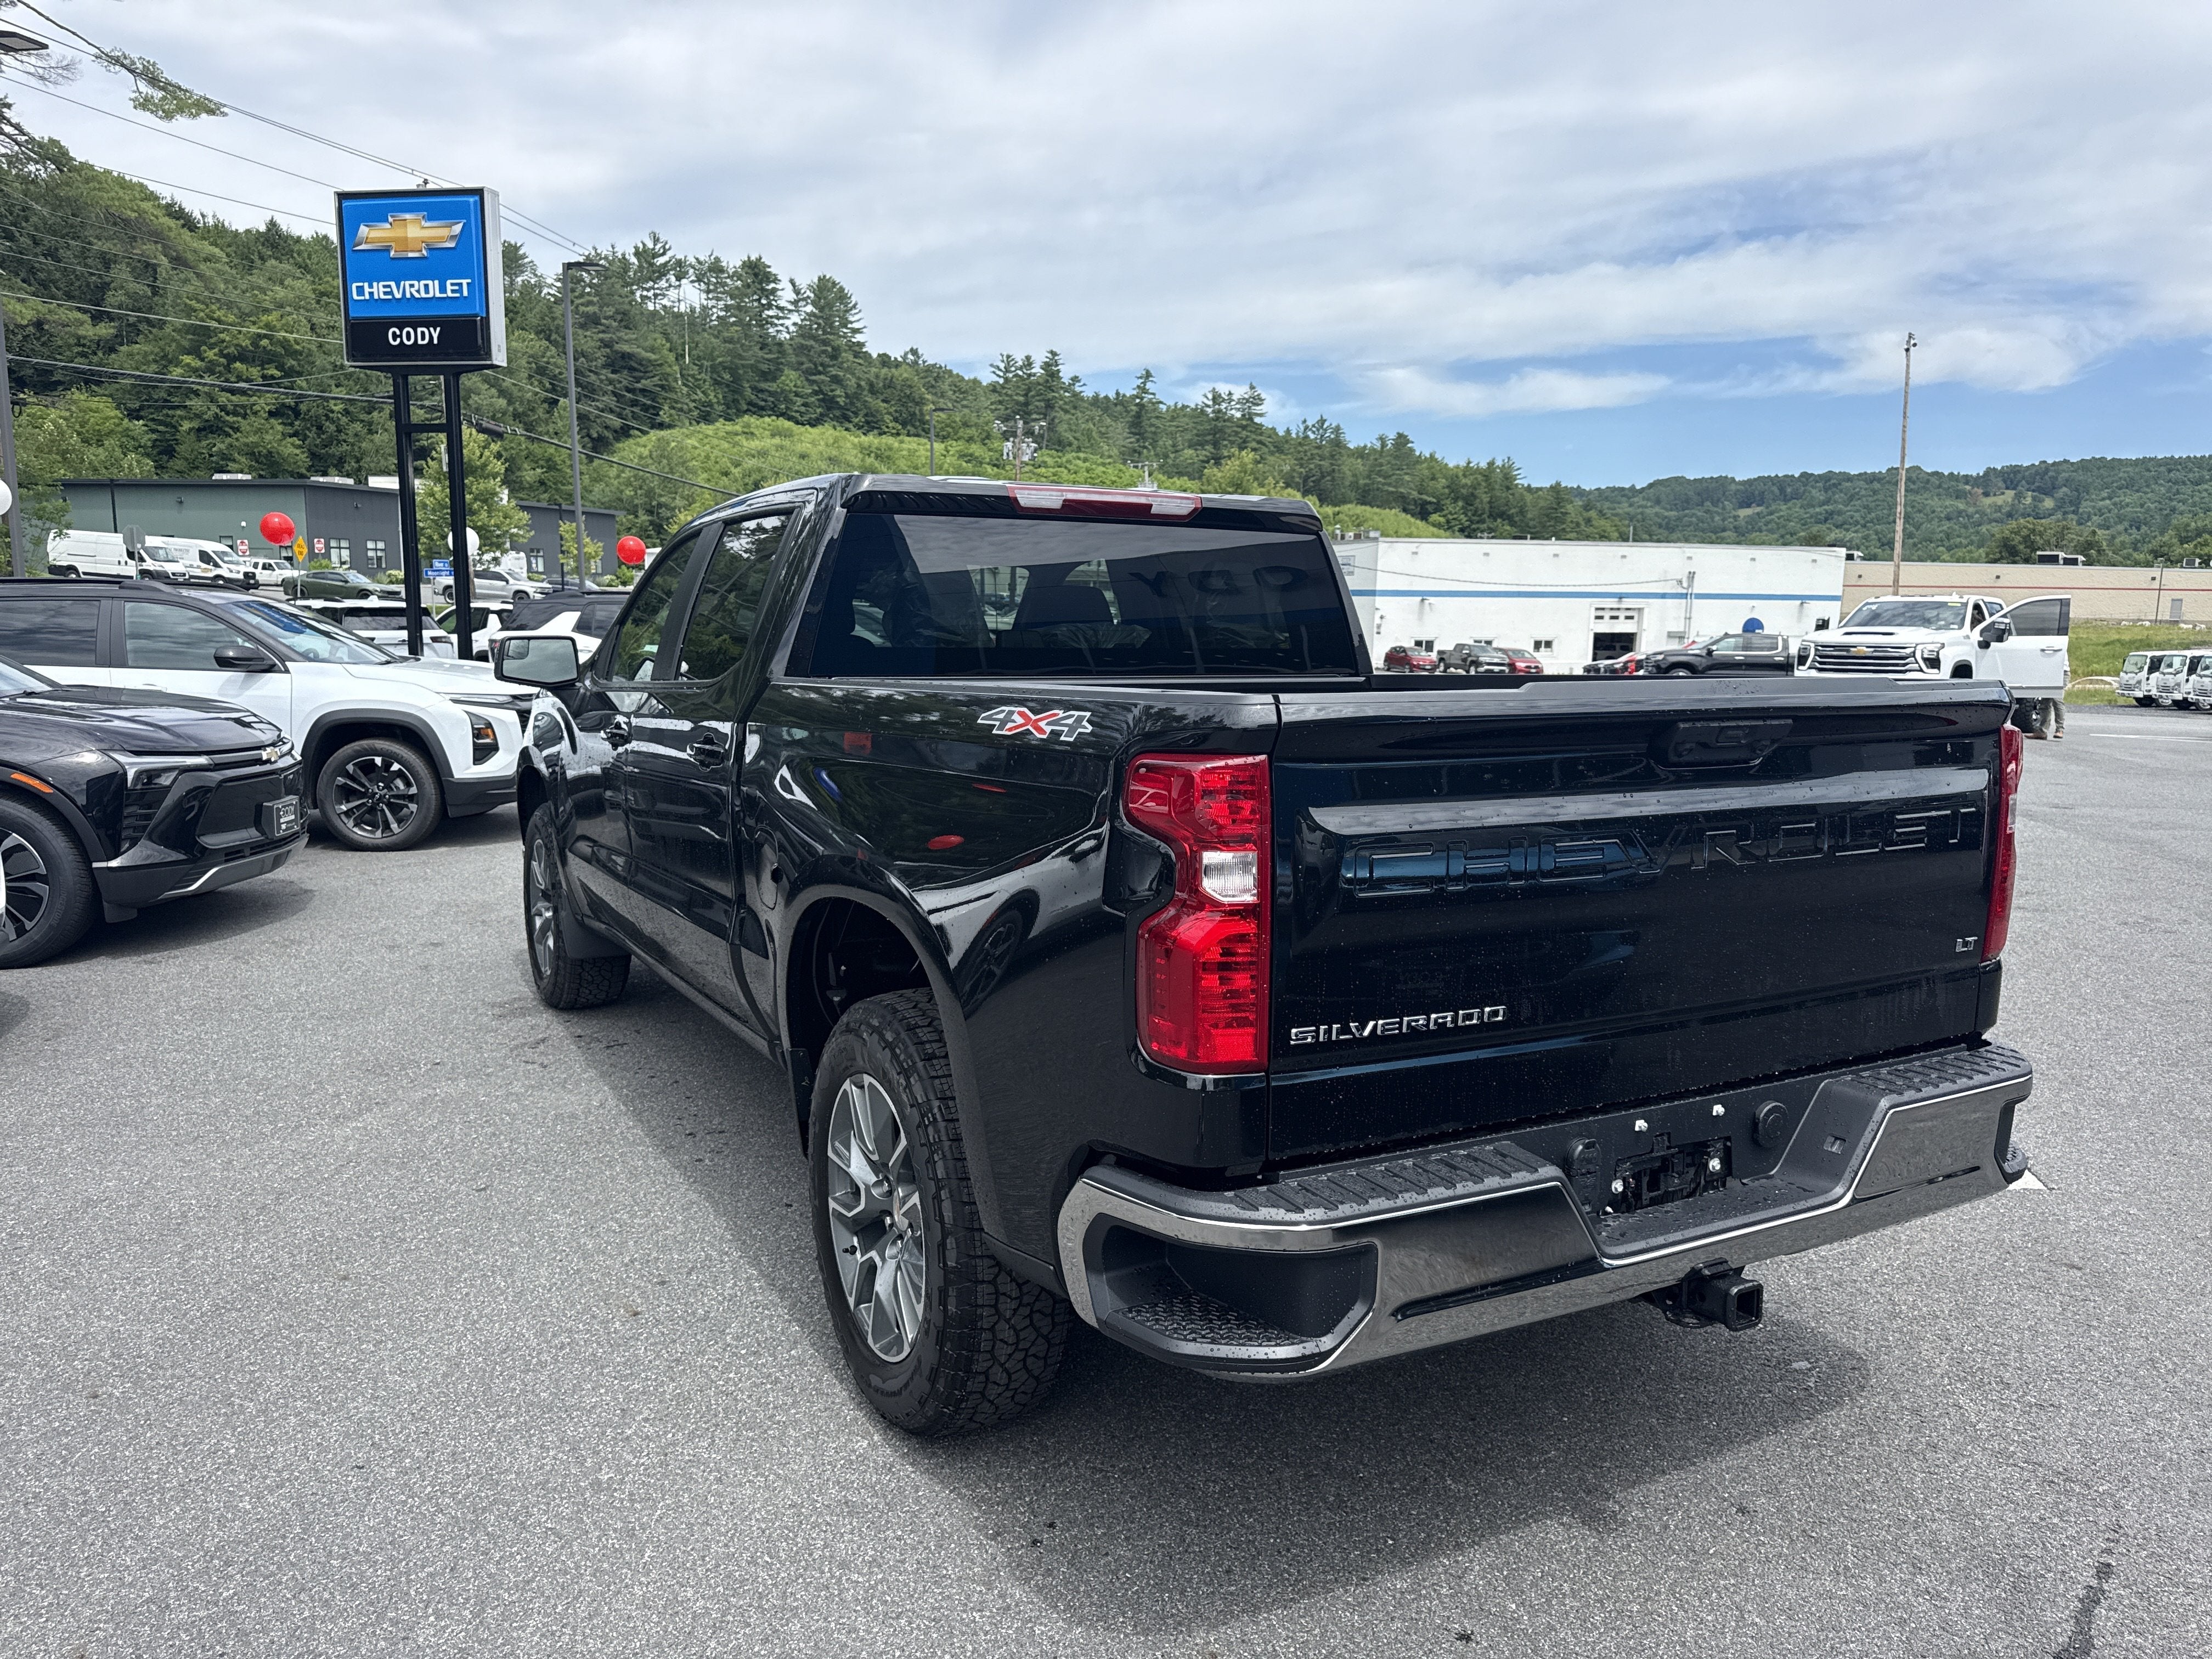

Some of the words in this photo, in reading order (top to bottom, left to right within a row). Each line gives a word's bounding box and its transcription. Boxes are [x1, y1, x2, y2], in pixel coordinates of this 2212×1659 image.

[352, 279, 471, 300] CHEVROLET
[388, 326, 441, 346] CODY
[280, 805, 295, 818] CODY
[1354, 801, 1979, 899] CHEVROLET
[1955, 936, 1978, 952] LT
[1289, 1005, 1508, 1046] SILVERADO
